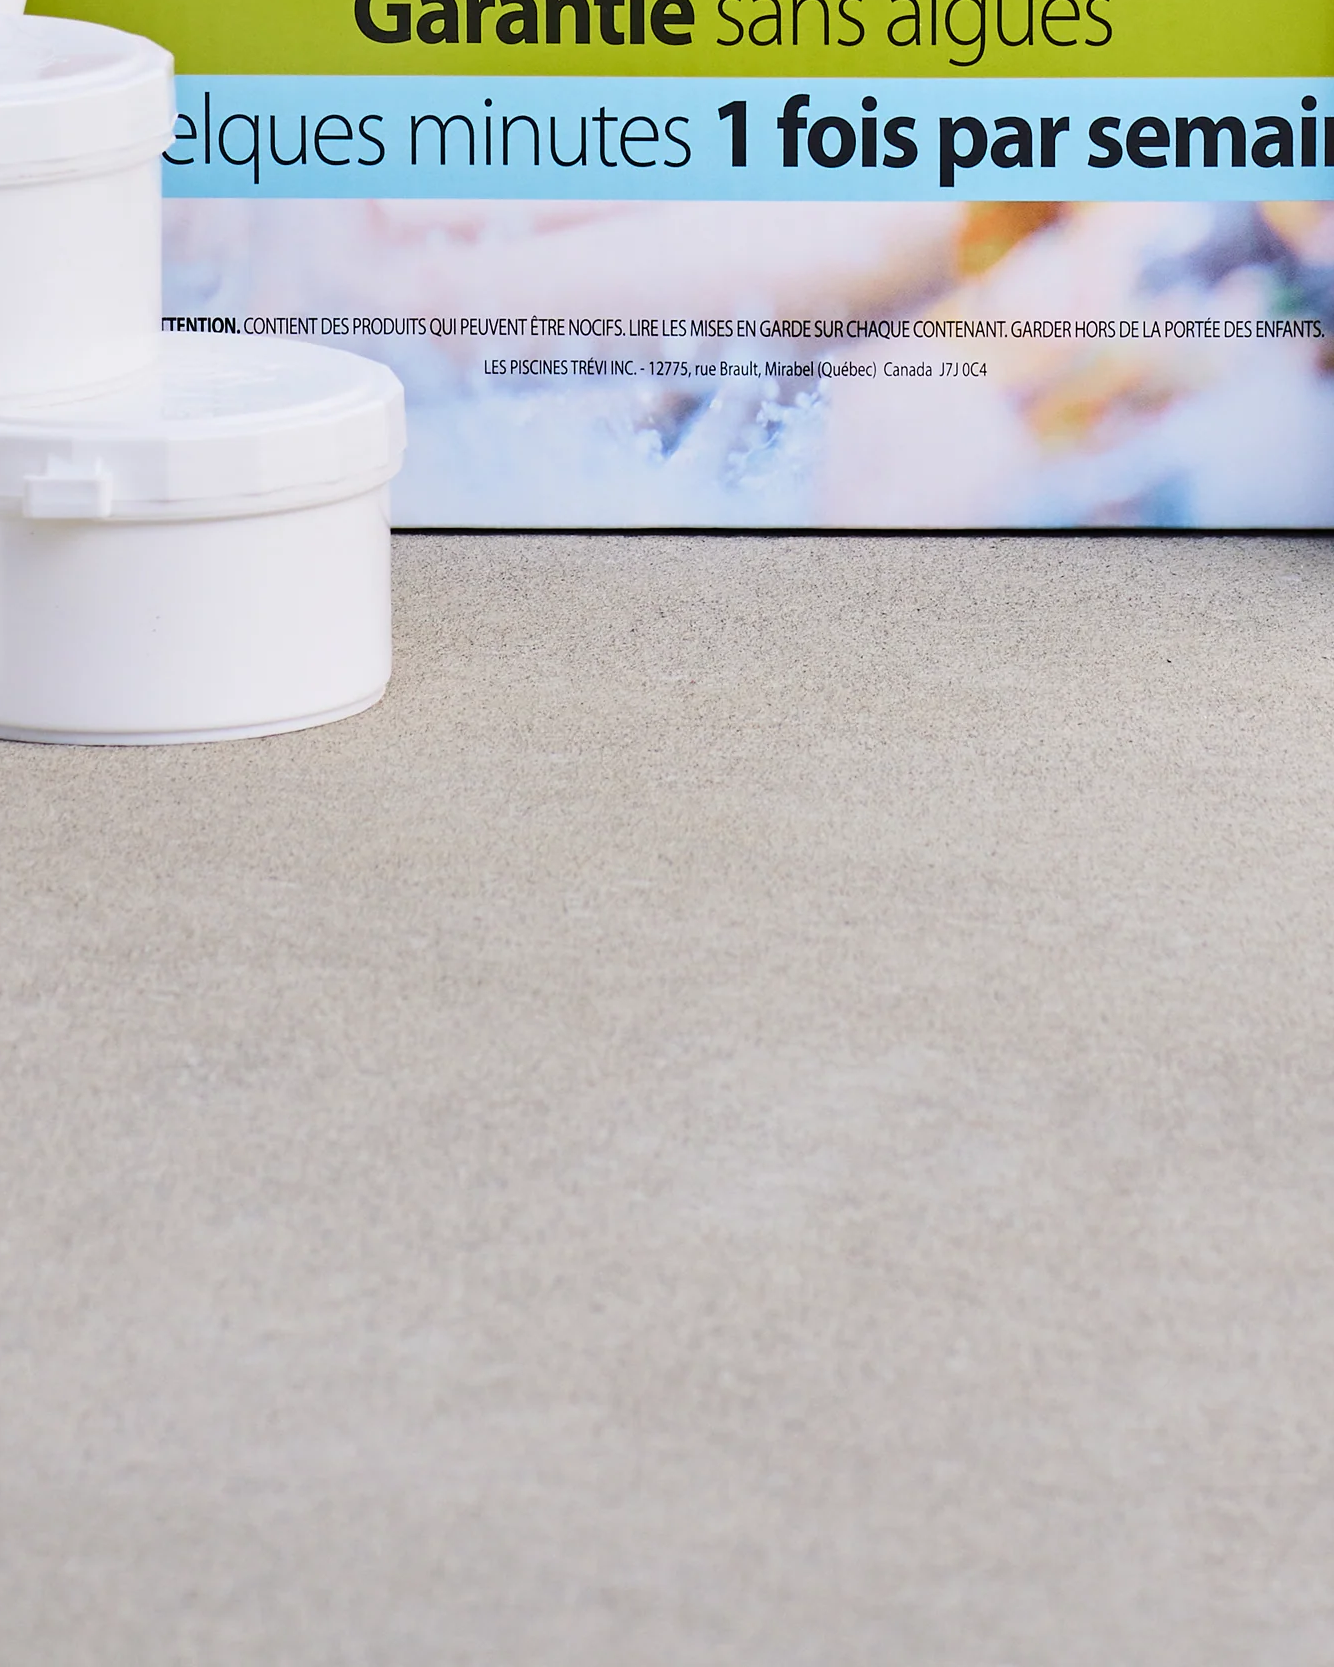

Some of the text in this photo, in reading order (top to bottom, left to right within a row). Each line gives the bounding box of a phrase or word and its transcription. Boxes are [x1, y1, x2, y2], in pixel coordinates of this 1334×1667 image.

[162, 91, 385, 185] elques
[410, 98, 691, 168] minutes
[717, 99, 747, 167] 1
[777, 94, 917, 169] fois
[939, 113, 1069, 188] par
[162, 315, 1325, 341] TTENTION. CONTIENT DES PRODUITS QUI PEUVENT ÊTRE NOCIFS. LIRE LES MISES EN GARDE SUR CHAQUE CONTENANT. GARDER HORS DE LA PORTÉE DES ENFANTS.
[484, 360, 506, 375] LES
[510, 360, 568, 376] PISCINES
[571, 357, 607, 375] TRÉVI
[611, 360, 636, 376] INC.
[649, 361, 691, 378] 12775,
[695, 365, 716, 376] rue
[720, 361, 761, 379] Brault,
[765, 361, 814, 377] Mirabel
[818, 361, 876, 379] (Québec)
[883, 362, 932, 377] Canada
[939, 362, 959, 377] J7J
